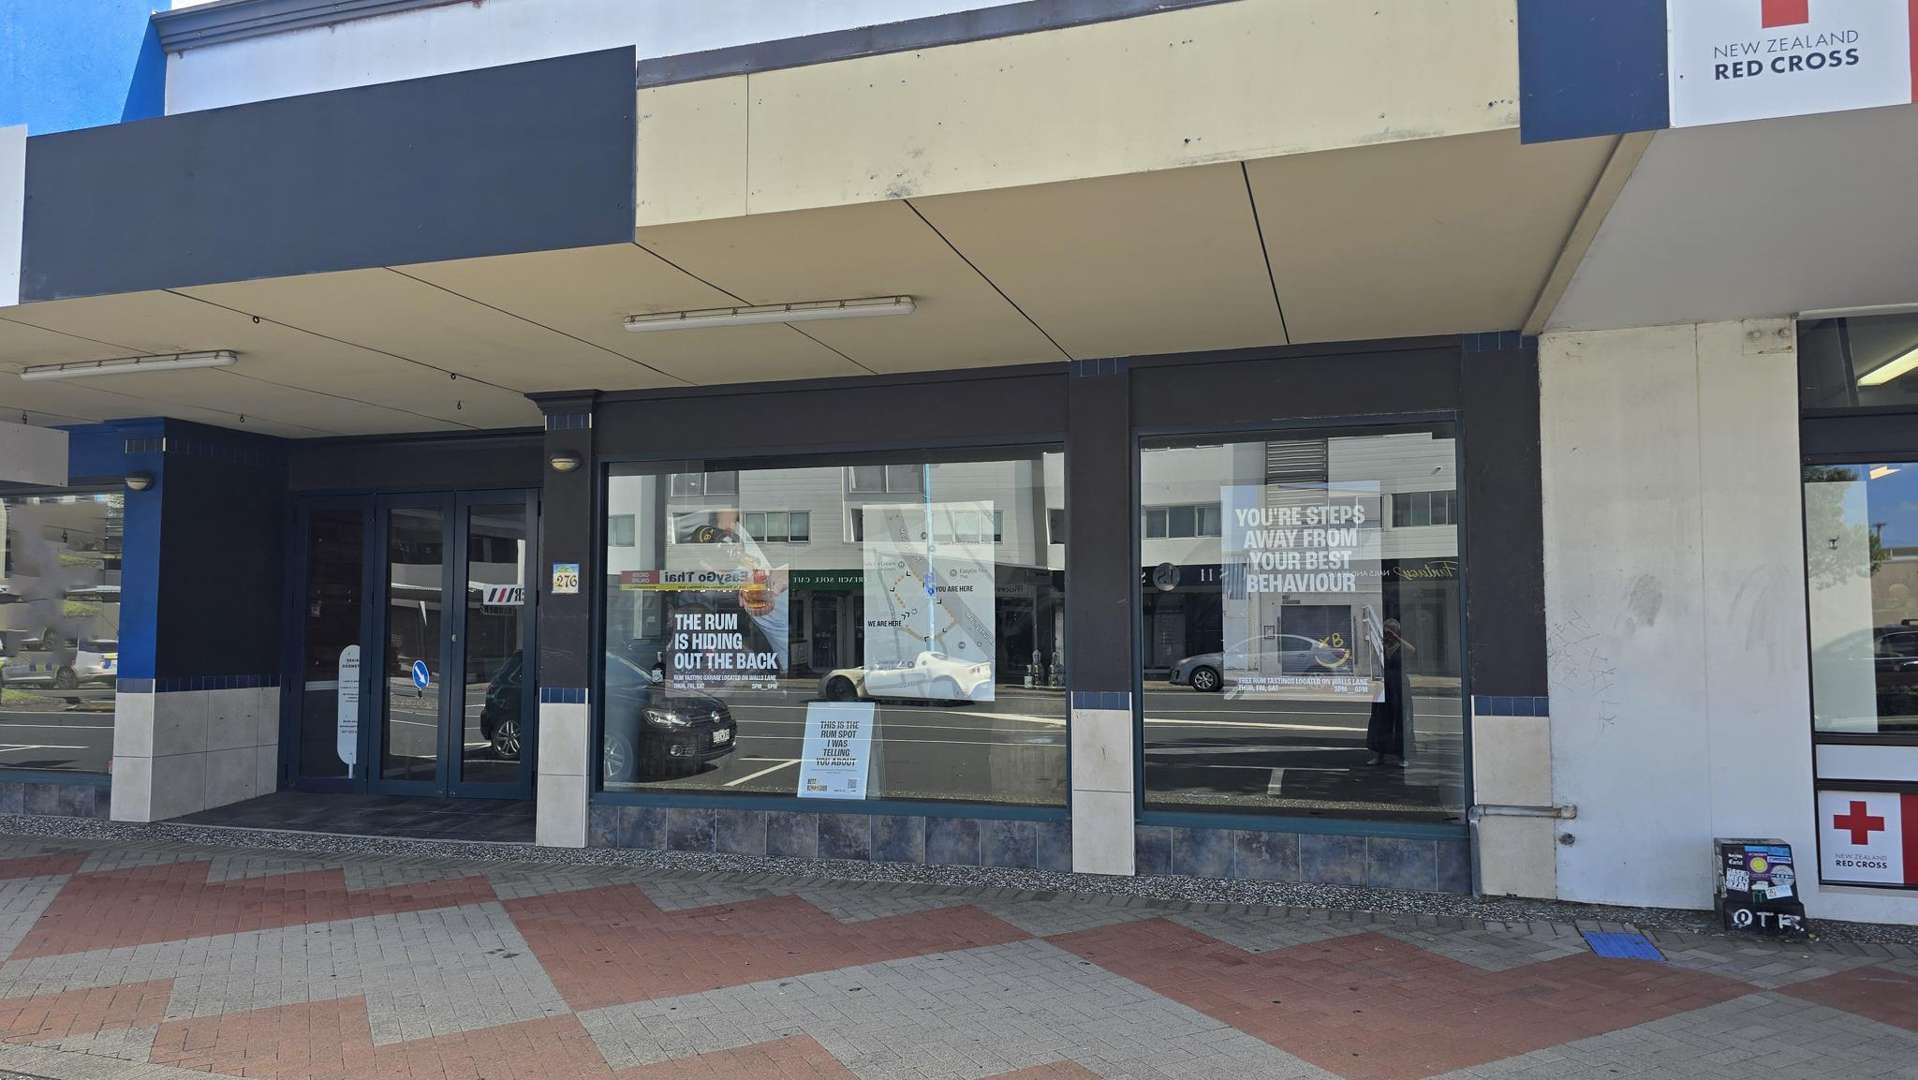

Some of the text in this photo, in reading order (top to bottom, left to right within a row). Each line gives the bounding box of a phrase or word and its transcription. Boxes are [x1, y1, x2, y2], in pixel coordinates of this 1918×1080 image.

[1714, 30, 1859, 59] NEW ZEALAND
[1715, 48, 1859, 80] RED CROSS
[1235, 505, 1365, 527] YOU'RE STEPS
[1244, 528, 1357, 548] AWAY FROM
[1249, 551, 1352, 570] YOUR BEST
[555, 575, 577, 588] 276
[1247, 573, 1356, 592] BEHAVIOUR
[675, 613, 738, 630] THE RUM
[674, 633, 742, 650] IS HIDING
[674, 652, 778, 670] OUT THE BACK
[1352, 678, 1368, 686] LANE
[820, 721, 860, 729] THIS IS THE
[820, 730, 857, 738] RUM SPOT
[823, 748, 850, 757] TELLING
[816, 758, 857, 766] YOU ABOUT
[1836, 860, 1888, 869] RED CROSS
[1854, 853, 1888, 861] ZEALAND
